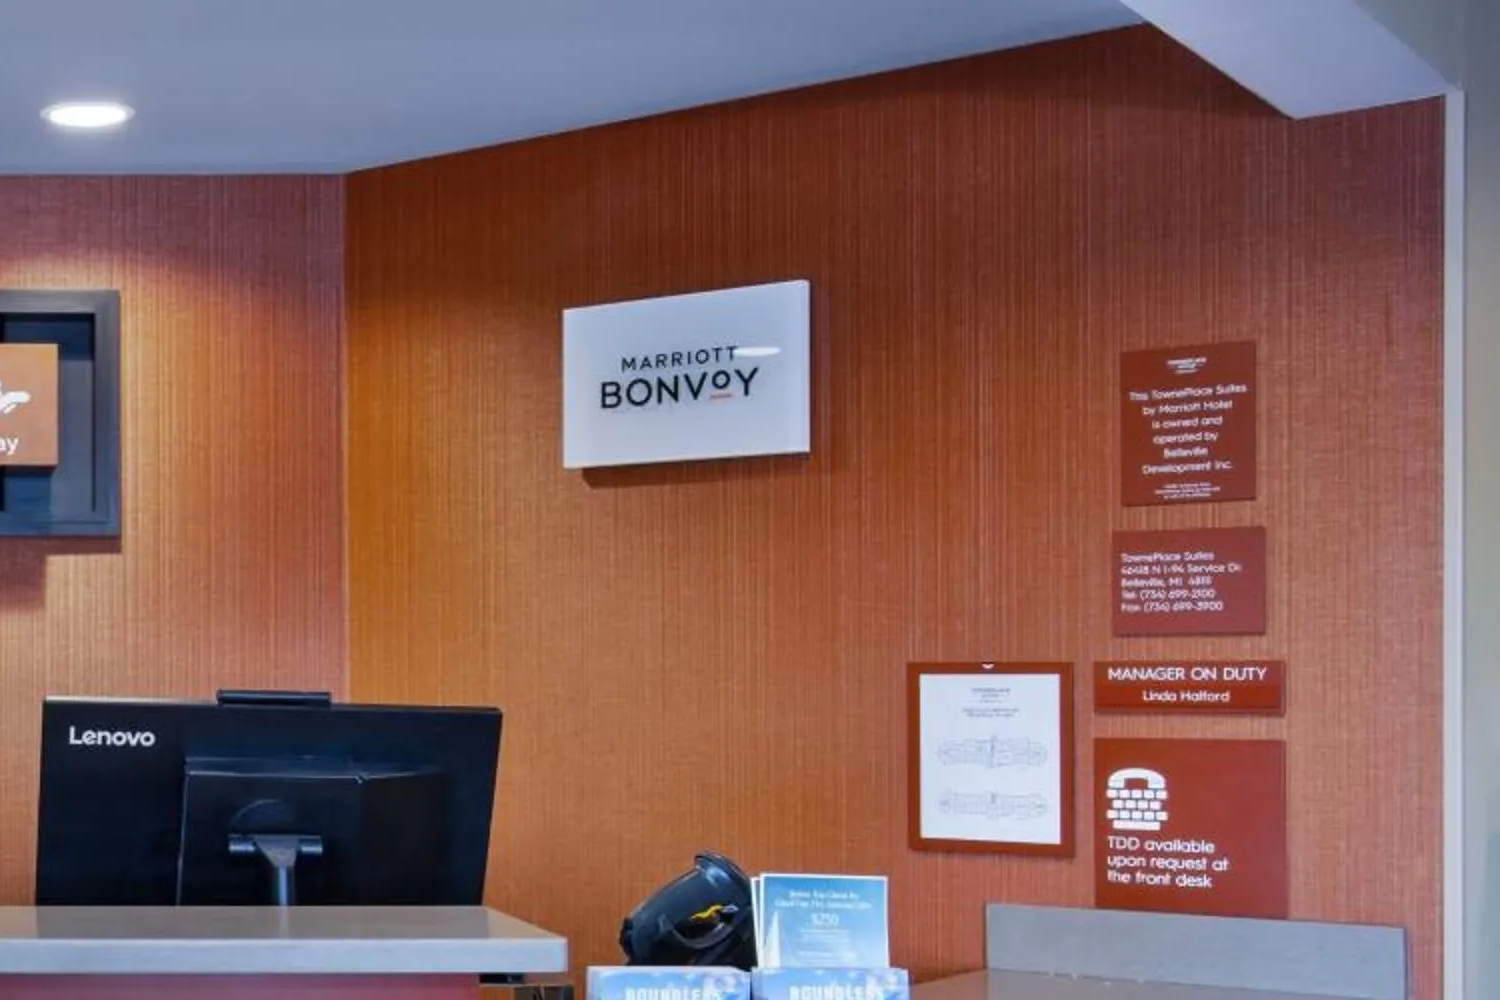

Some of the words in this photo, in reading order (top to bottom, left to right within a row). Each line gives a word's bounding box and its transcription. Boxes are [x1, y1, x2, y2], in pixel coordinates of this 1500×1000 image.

[621, 345, 738, 373] MARRIOTT
[1215, 384, 1247, 395] Suites
[1142, 406, 1156, 416] by
[1158, 402, 1201, 414] Marriott
[1203, 400, 1233, 410] Hotel
[1163, 417, 1199, 429] owned
[1201, 416, 1223, 426] and
[1153, 432, 1202, 445] operated
[1204, 432, 1219, 442] by
[1141, 461, 1211, 475] Development
[1187, 563, 1225, 573] Service
[1107, 667, 1185, 682] MANAGER
[1190, 667, 1217, 682] ON
[1223, 667, 1267, 681] DUTY
[1142, 690, 1177, 702] Linda
[69, 725, 156, 748] Lenovo
[1107, 836, 1140, 849] TDD
[1144, 838, 1215, 854] available
[1107, 856, 1146, 870] upon
[1151, 855, 1207, 872] request
[1212, 858, 1229, 871] at
[1107, 870, 1131, 883] the
[1135, 871, 1171, 885] front
[1175, 873, 1213, 888] desk
